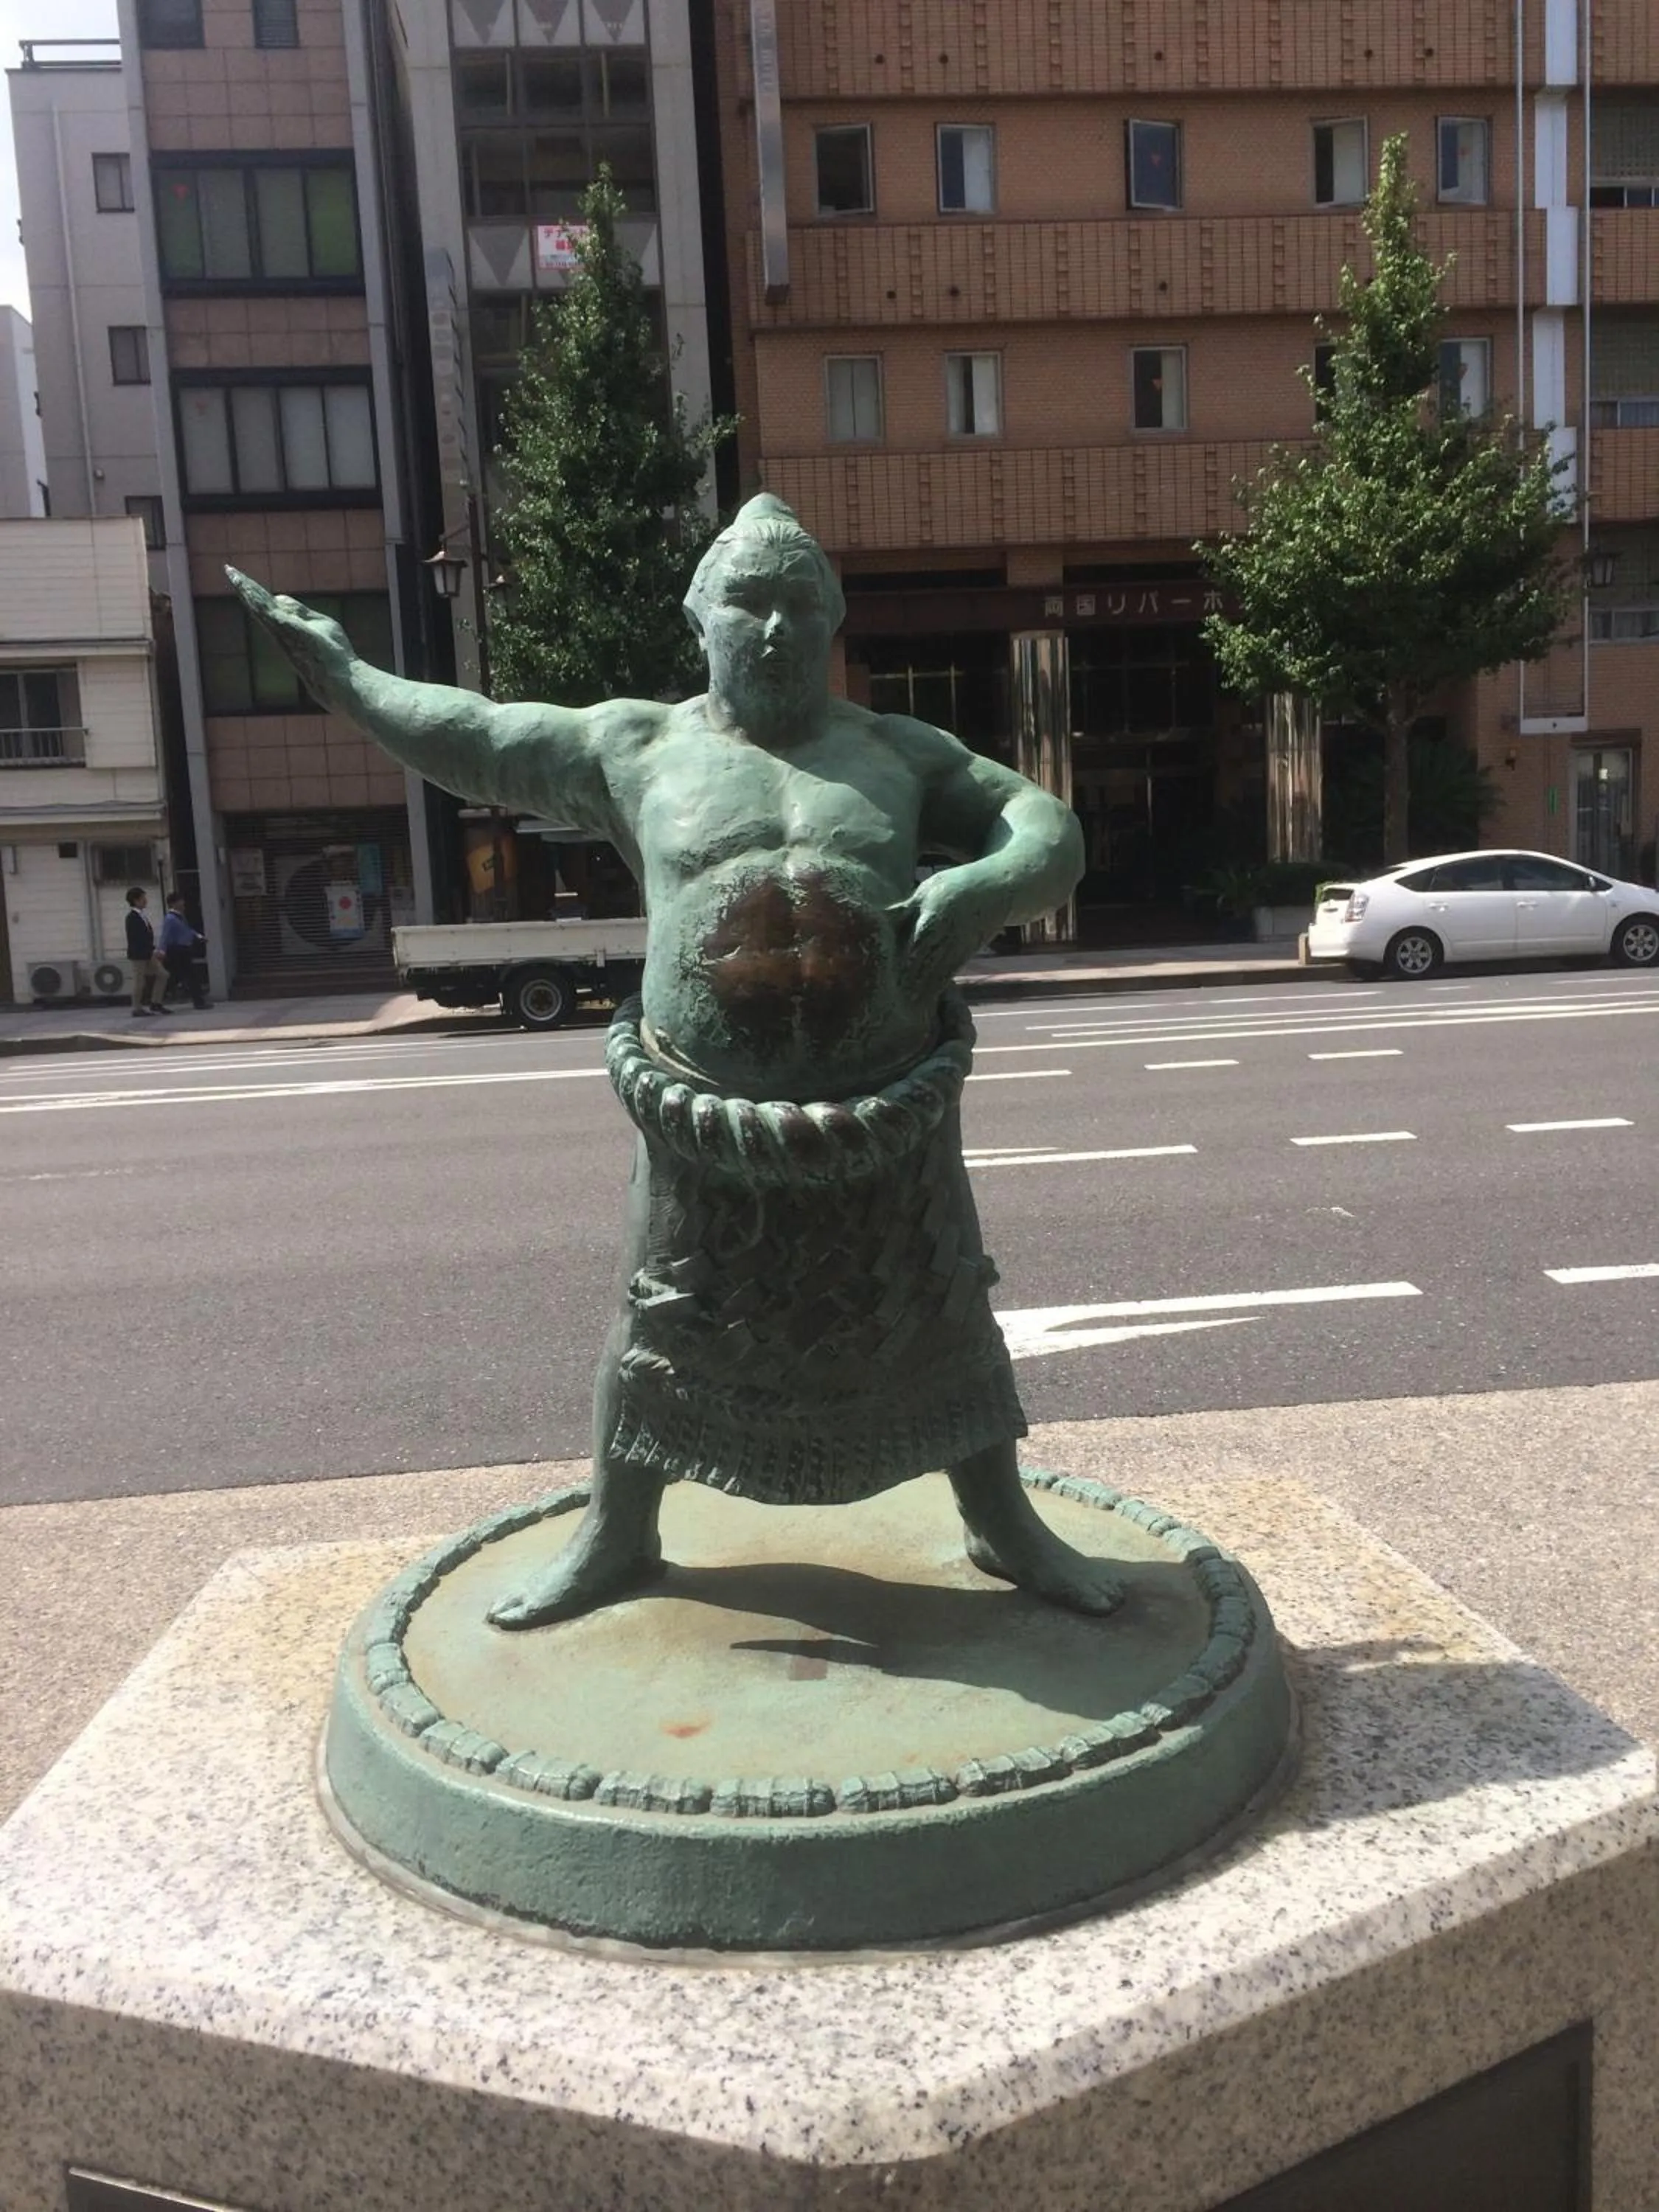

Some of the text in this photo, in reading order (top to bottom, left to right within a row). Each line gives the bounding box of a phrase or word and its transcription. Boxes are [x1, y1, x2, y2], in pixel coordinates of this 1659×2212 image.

[1044, 589, 1248, 618] 両国リバーホ
